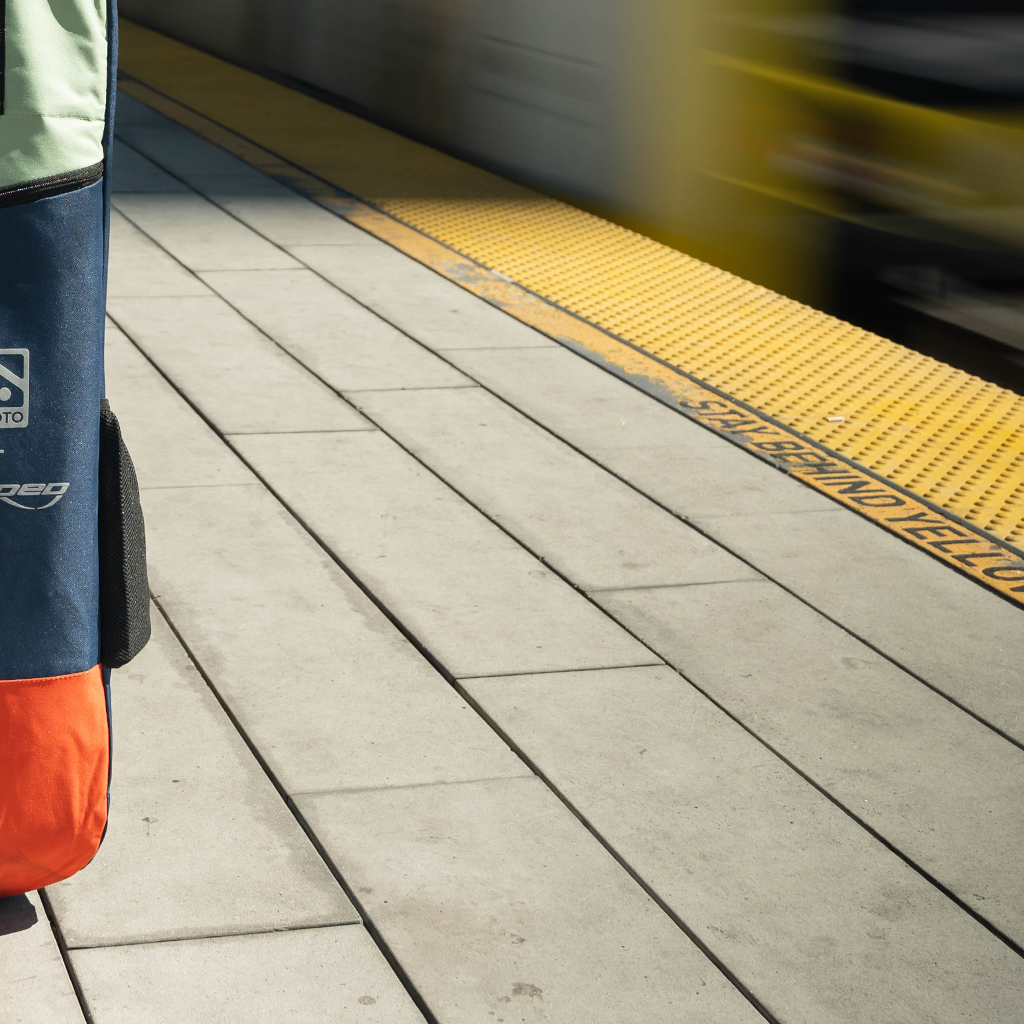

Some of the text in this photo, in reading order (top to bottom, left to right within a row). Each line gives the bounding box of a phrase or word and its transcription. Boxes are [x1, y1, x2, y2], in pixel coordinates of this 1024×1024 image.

[679, 400, 1024, 592] STAY BEHIND YELLO
